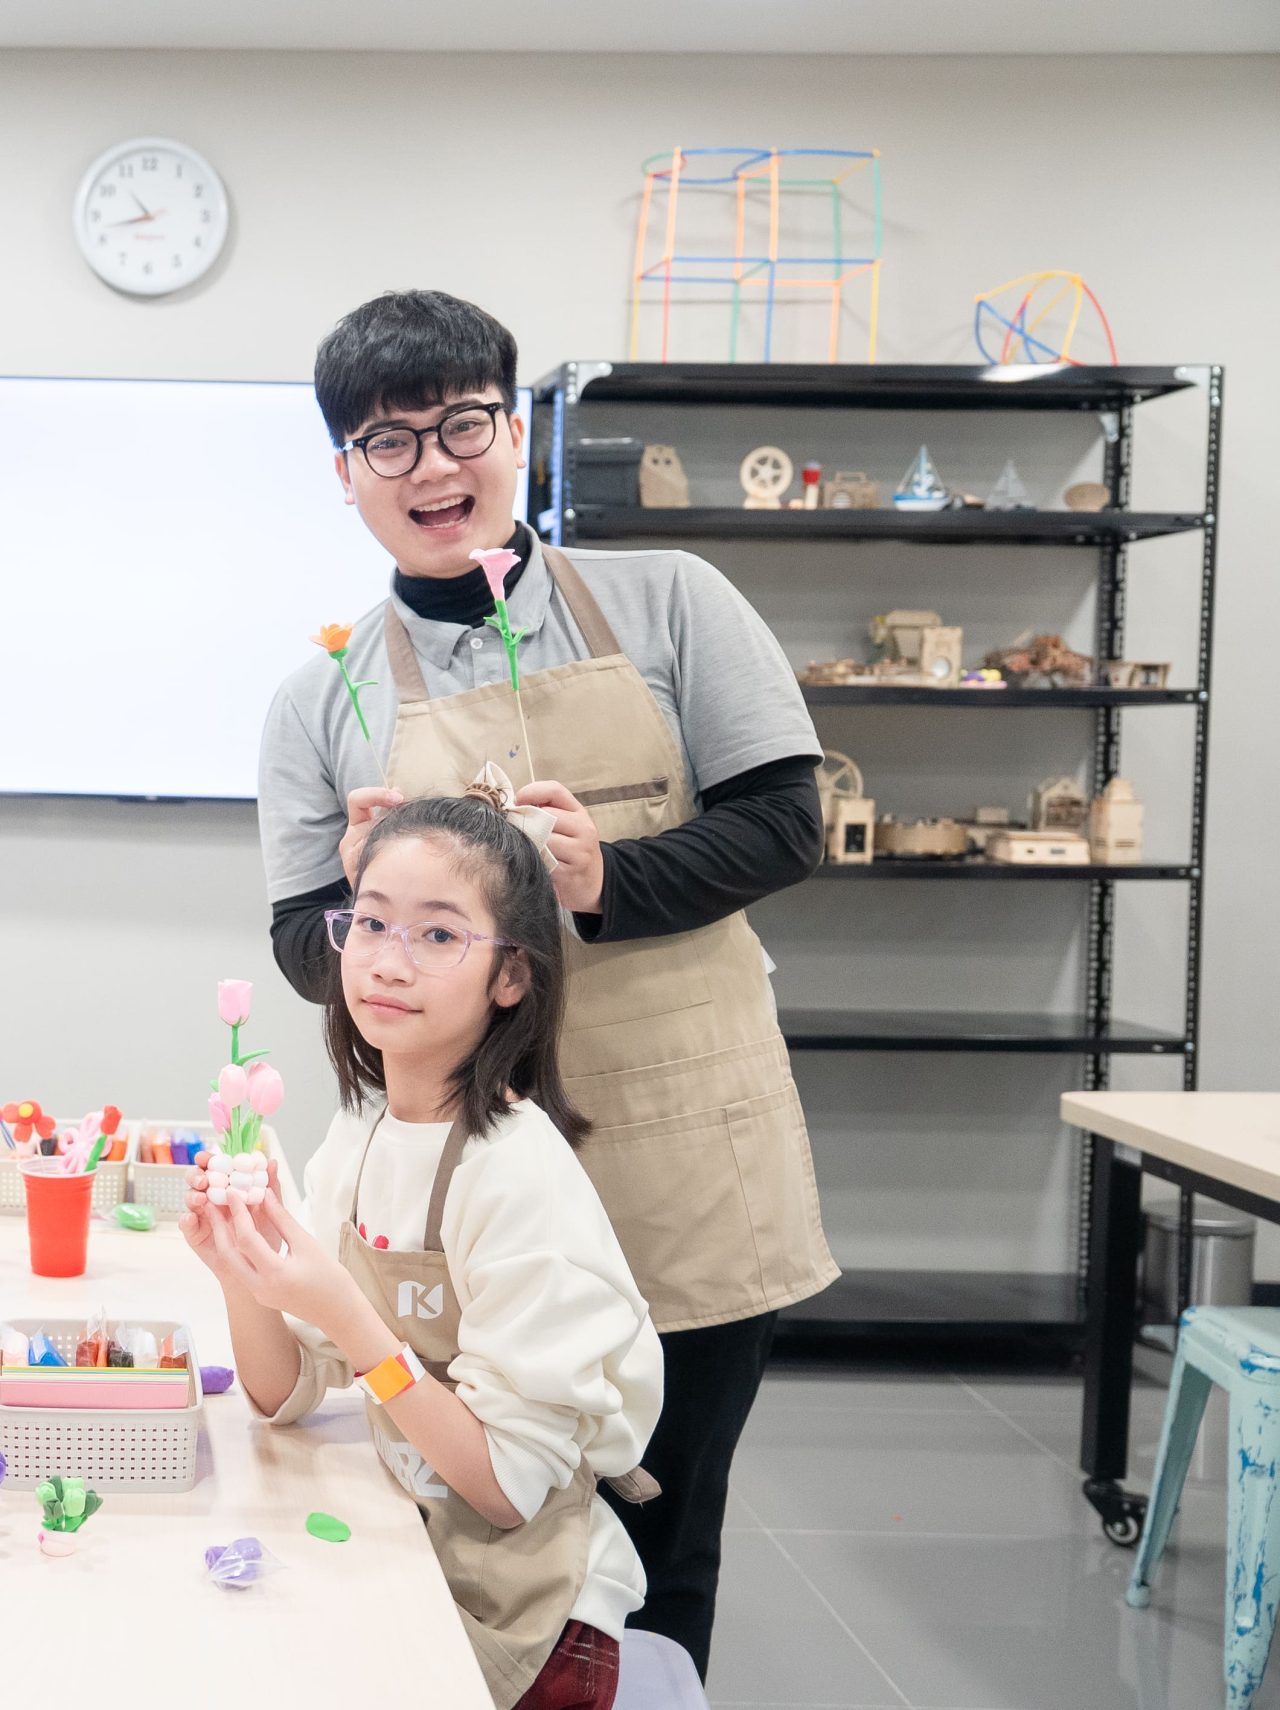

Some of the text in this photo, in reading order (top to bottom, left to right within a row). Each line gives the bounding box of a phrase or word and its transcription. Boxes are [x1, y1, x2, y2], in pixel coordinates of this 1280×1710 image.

[117, 163, 134, 178] 11
[141, 157, 158, 172] 12
[99, 184, 116, 198] 10
